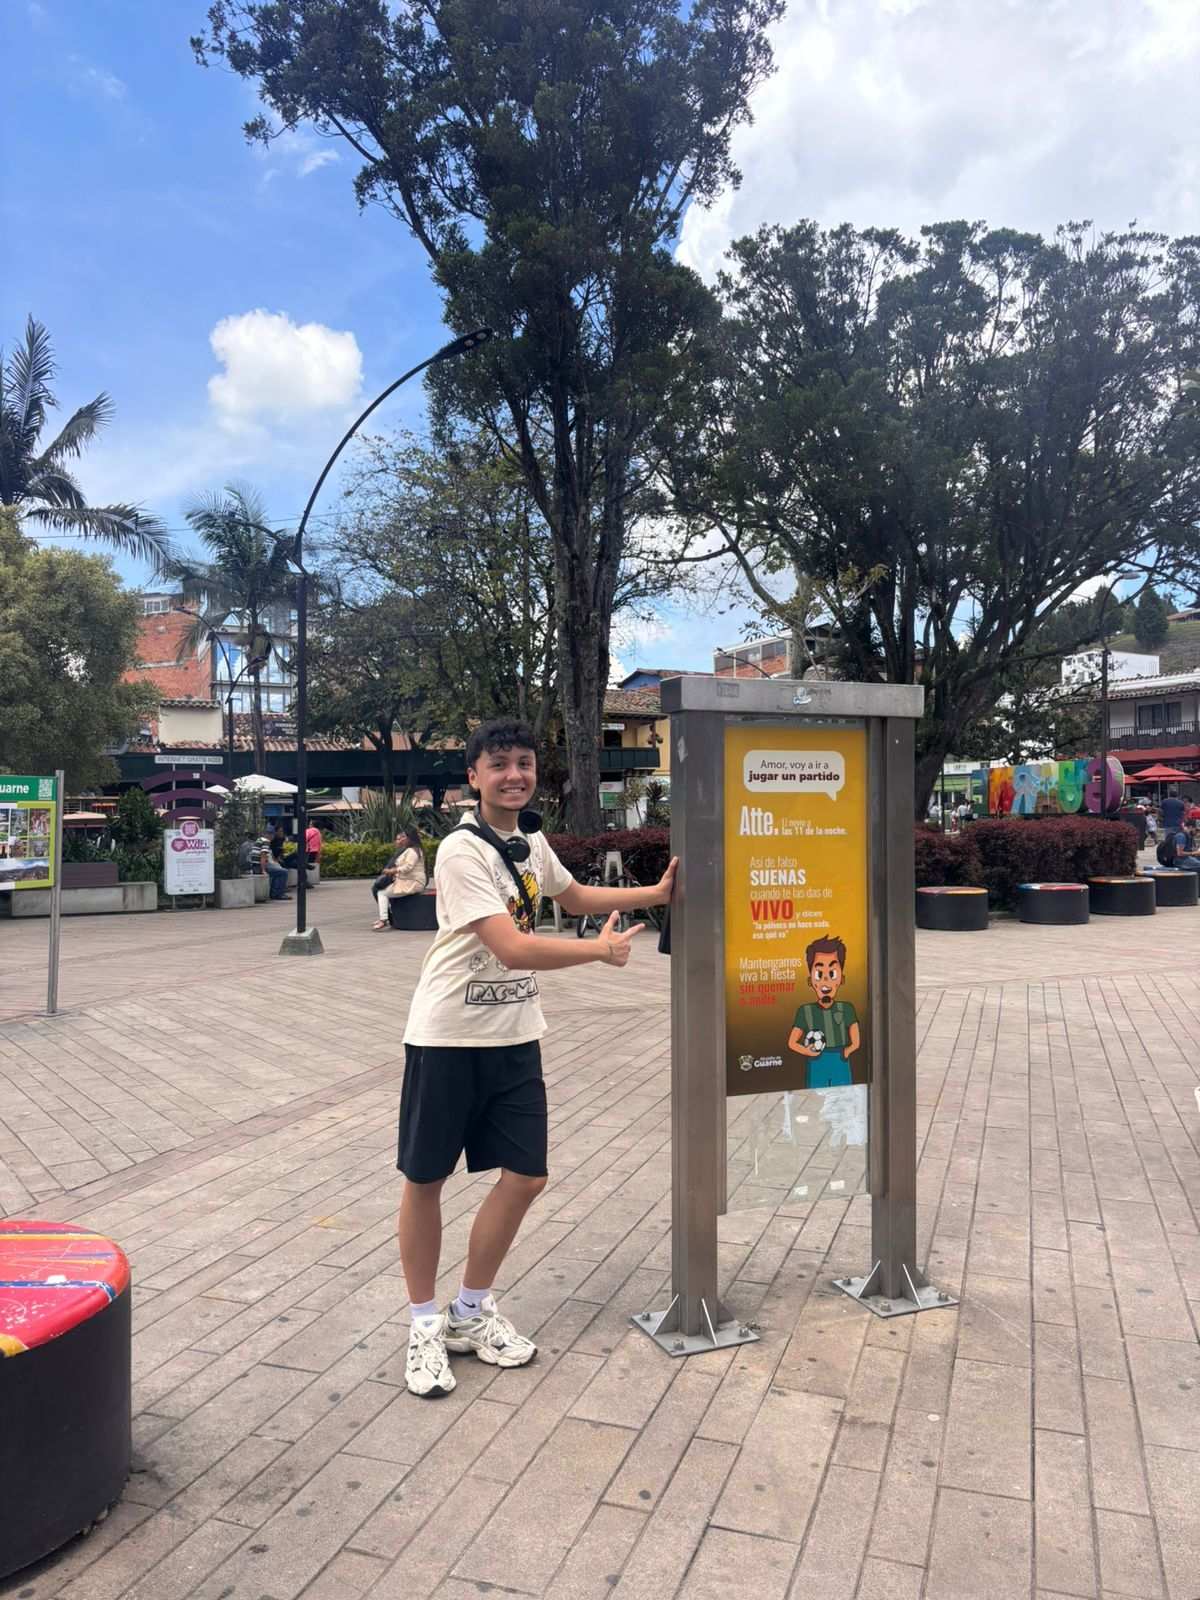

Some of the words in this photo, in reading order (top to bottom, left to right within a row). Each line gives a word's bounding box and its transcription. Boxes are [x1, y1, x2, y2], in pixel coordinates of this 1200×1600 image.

[760, 759, 788, 770] Amor,
[790, 762, 805, 771] voy
[815, 760, 823, 769] ir
[748, 770, 779, 782] jugar
[782, 773, 796, 781] un
[799, 771, 840, 783] partido
[740, 805, 779, 836] Atte.
[795, 826, 803, 835] 11
[805, 826, 814, 835] de
[764, 856, 775, 868] de
[777, 855, 798, 868] falso
[750, 869, 806, 886] SUENAS
[750, 887, 780, 899] cuando
[782, 887, 791, 898] te
[792, 886, 804, 898] las
[806, 887, 821, 898] das
[822, 887, 833, 898] de
[751, 899, 794, 921] VIVO
[795, 911, 801, 920] y
[739, 957, 802, 971] Mantengamos
[740, 971, 758, 982] viva
[759, 970, 768, 981] la
[770, 968, 796, 981] fiesta
[740, 983, 754, 994] sin
[758, 981, 796, 995] quemar
[754, 1059, 783, 1068] Guarne
